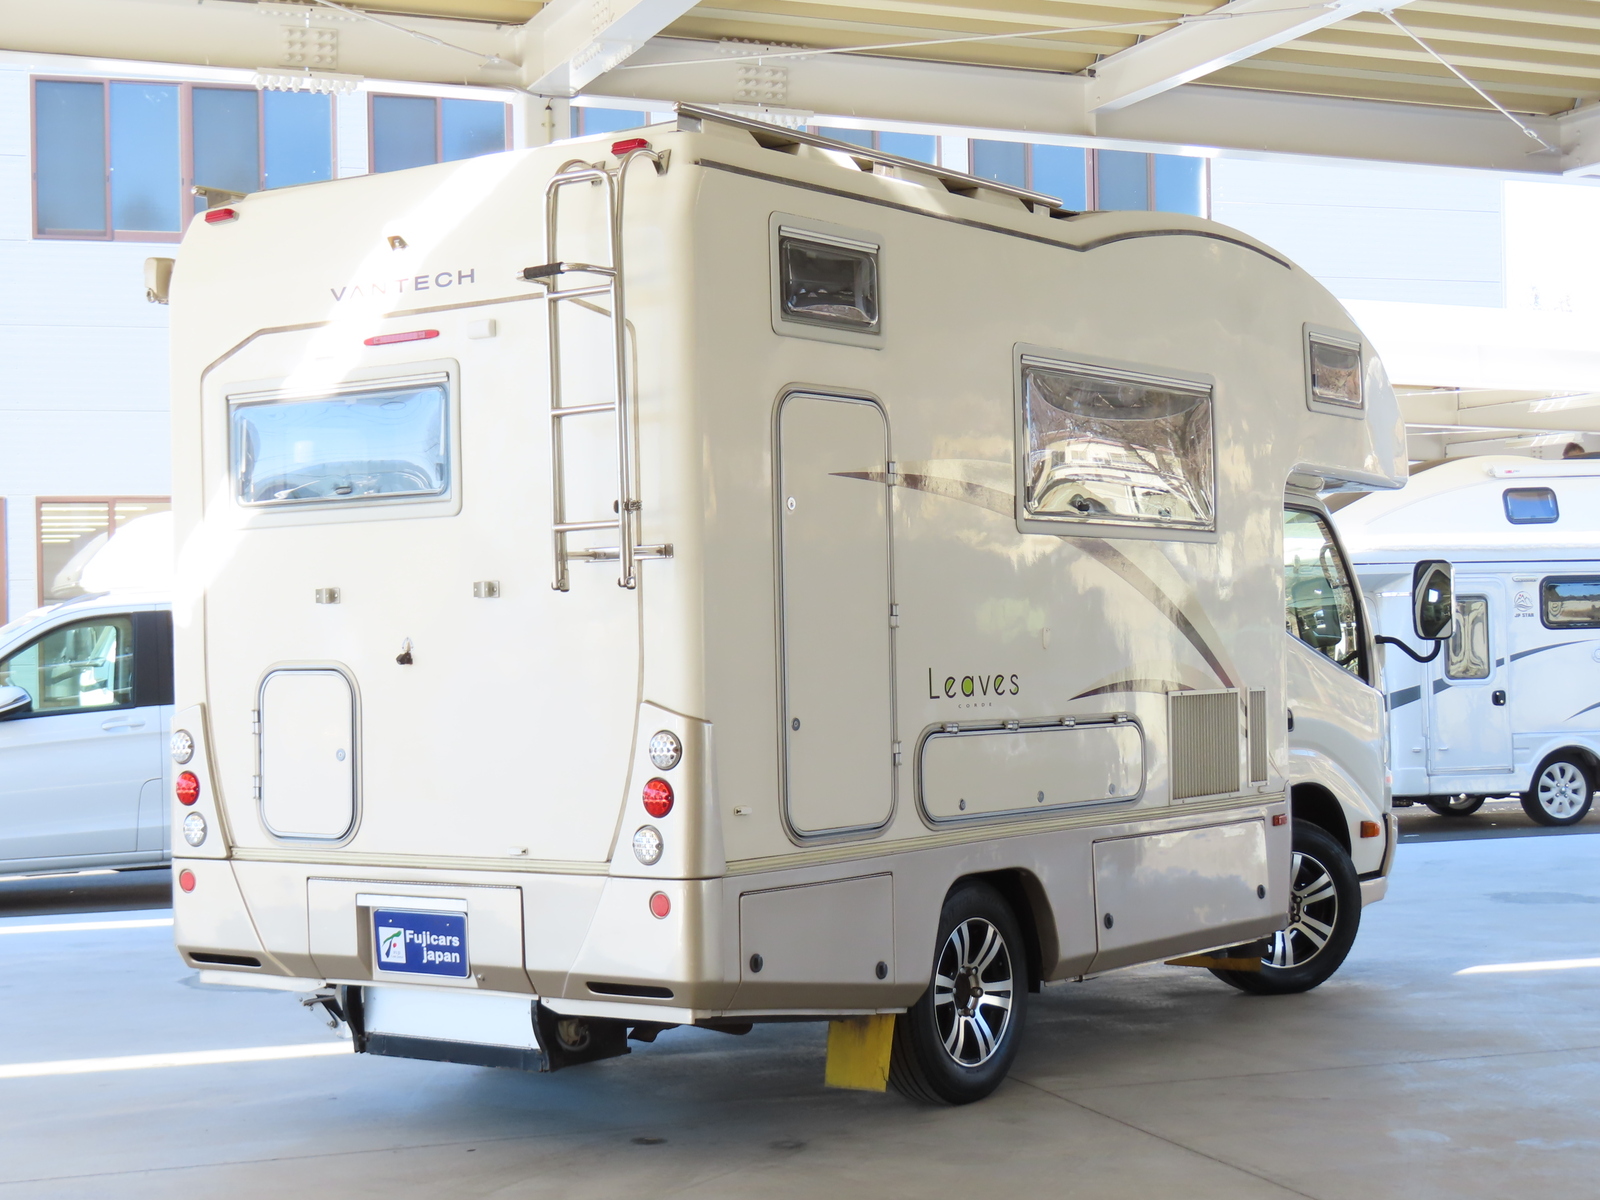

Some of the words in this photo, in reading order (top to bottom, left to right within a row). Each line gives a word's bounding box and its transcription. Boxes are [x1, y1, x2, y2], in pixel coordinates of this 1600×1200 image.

[330, 268, 475, 302] VANTECH
[928, 667, 1020, 700] Leaves
[405, 929, 460, 947] Fujicars
[422, 947, 460, 964] japan
